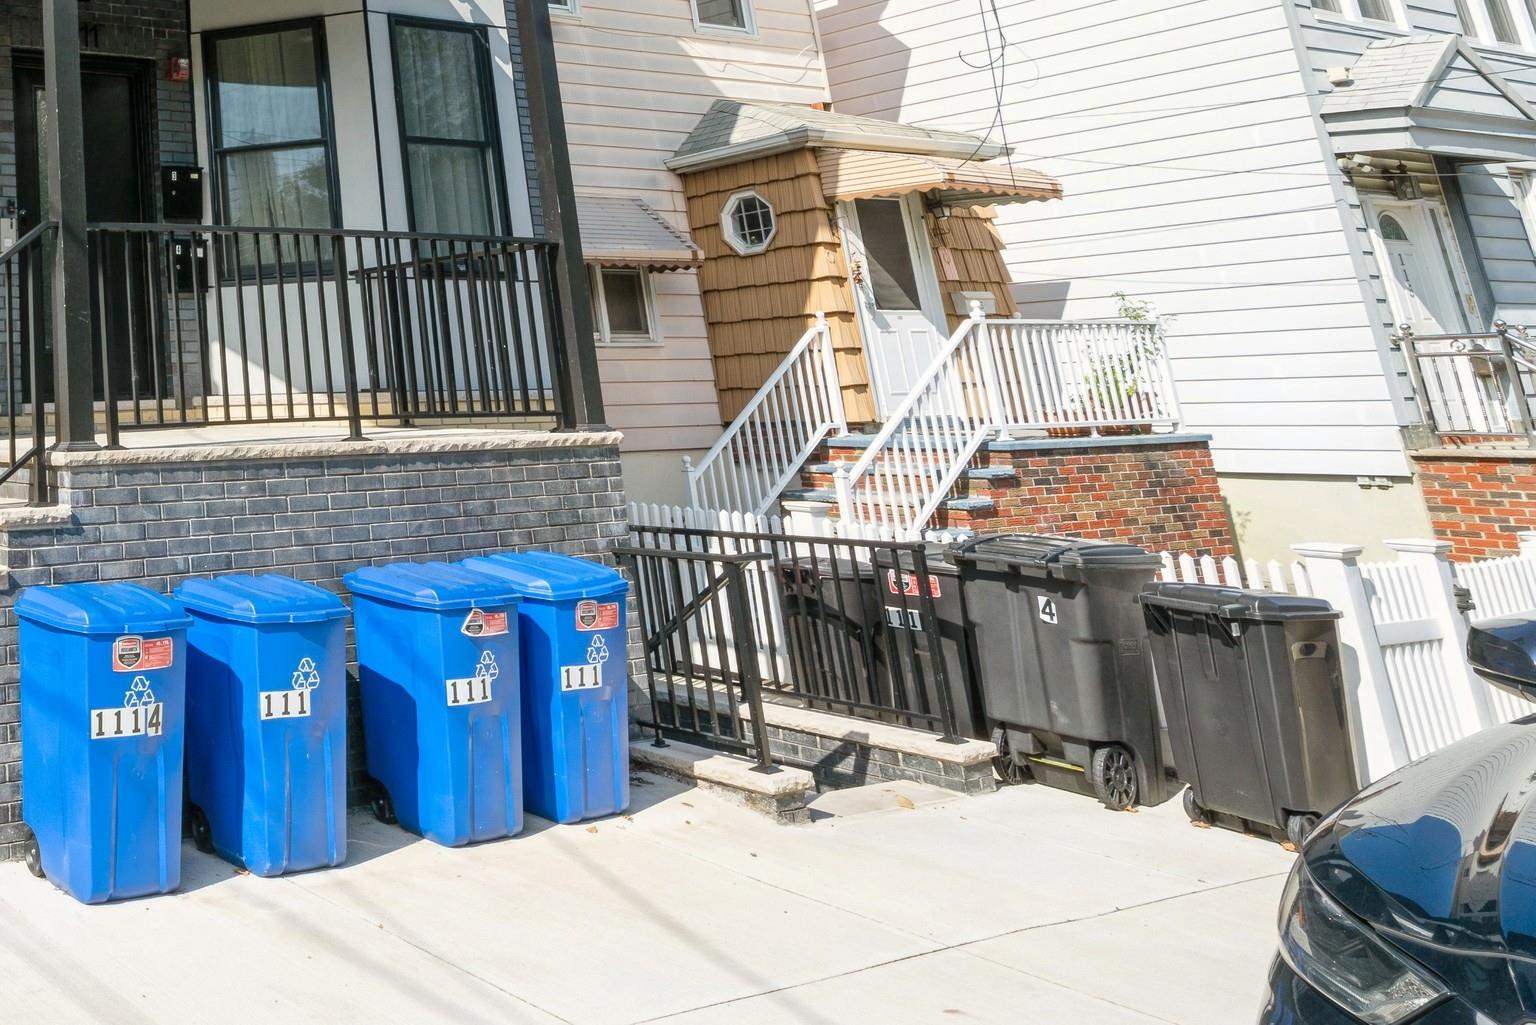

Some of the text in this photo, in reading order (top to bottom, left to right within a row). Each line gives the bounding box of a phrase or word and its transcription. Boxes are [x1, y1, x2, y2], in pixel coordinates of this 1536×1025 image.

[1041, 598, 1056, 622] 4
[565, 665, 600, 689] 111
[451, 678, 489, 704] 111
[265, 691, 307, 718] 111
